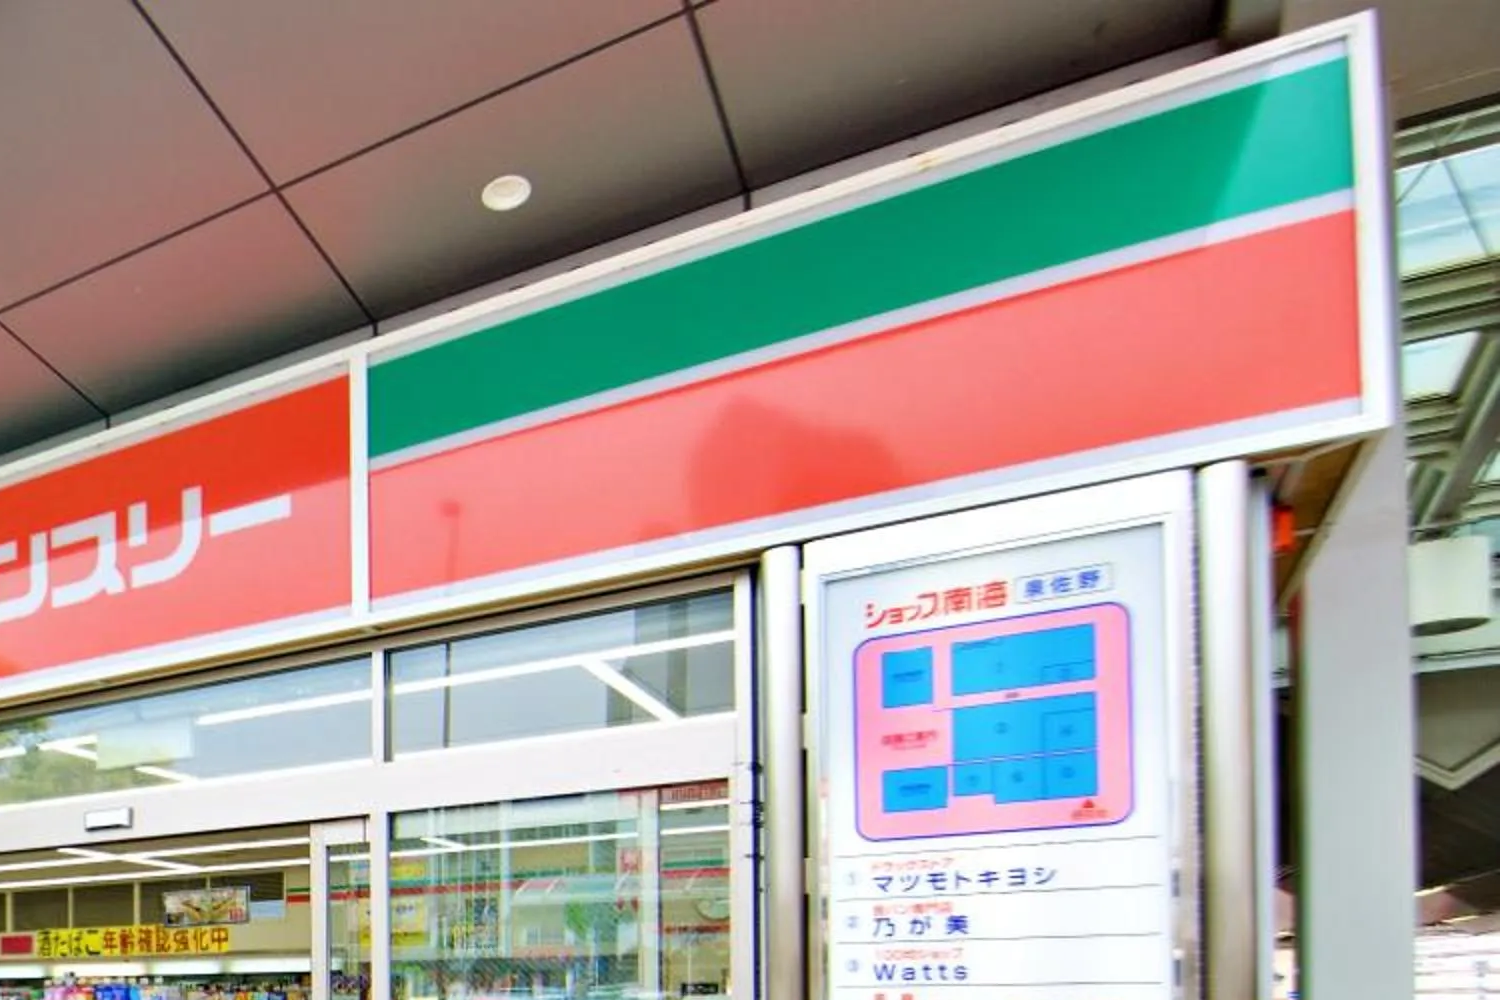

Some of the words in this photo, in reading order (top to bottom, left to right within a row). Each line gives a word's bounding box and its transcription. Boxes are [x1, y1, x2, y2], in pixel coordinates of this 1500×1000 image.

[864, 581, 1008, 629] ショップ南海
[872, 867, 1058, 892] マツモトキヨシ
[873, 963, 970, 981] Watts
